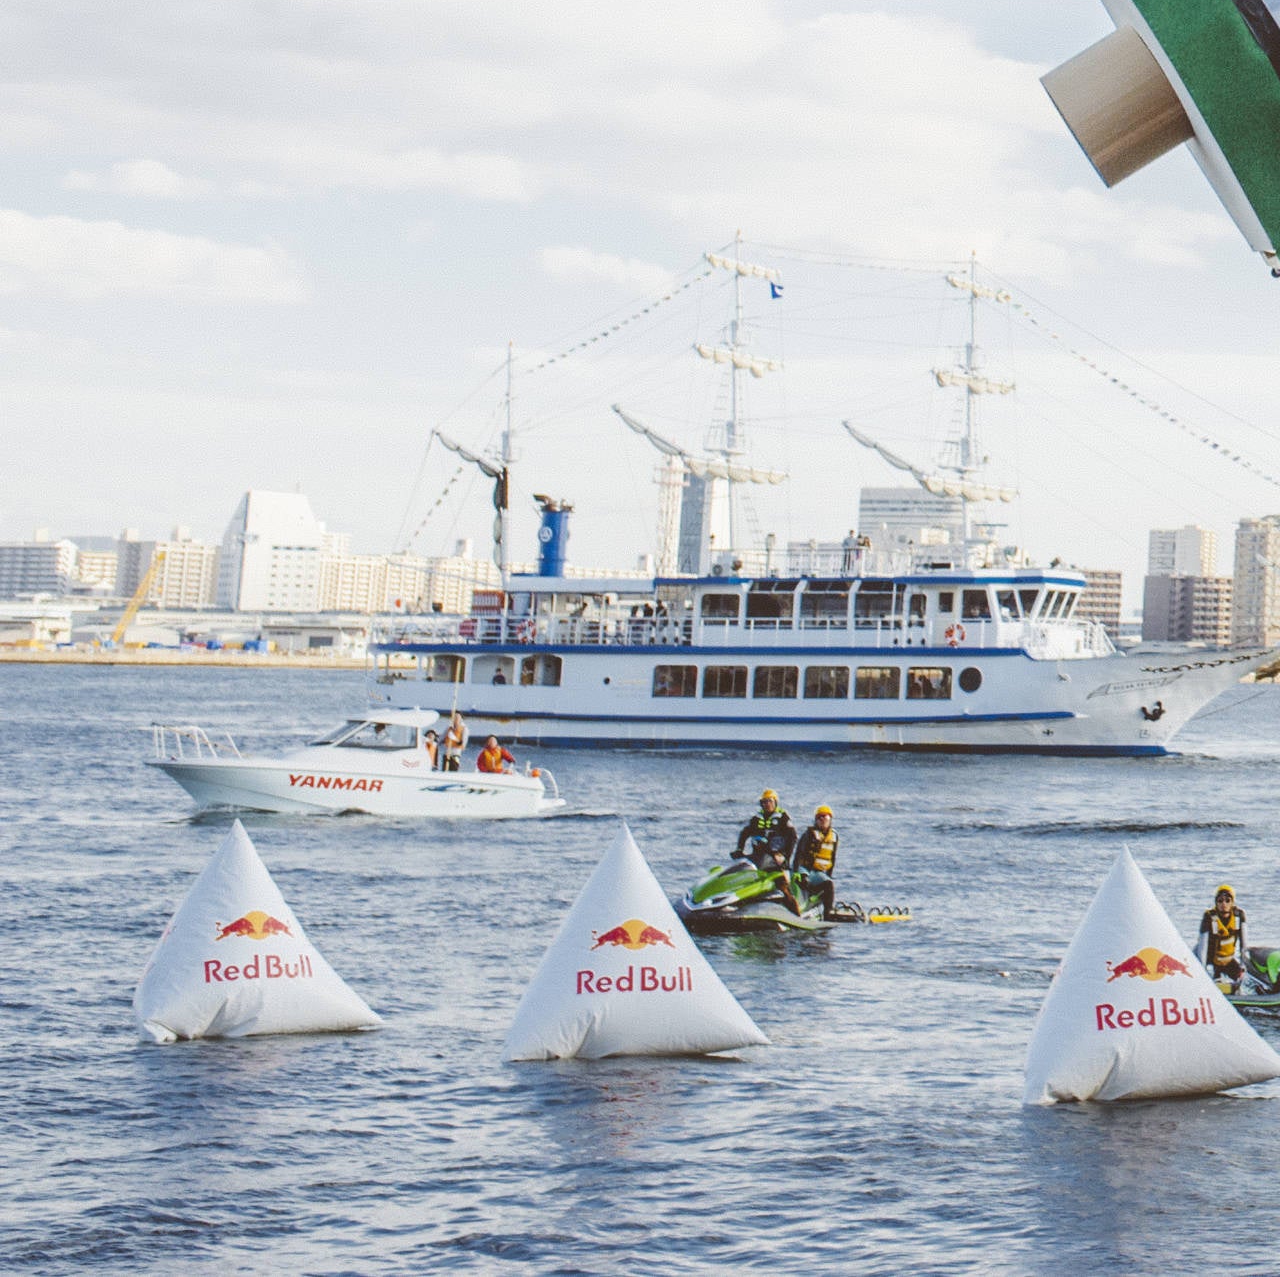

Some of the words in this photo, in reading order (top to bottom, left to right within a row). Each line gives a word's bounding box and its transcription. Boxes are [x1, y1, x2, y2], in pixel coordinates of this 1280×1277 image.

[288, 773, 385, 793] YANMAR
[203, 954, 260, 984] Red
[265, 953, 313, 979] Bull
[576, 965, 634, 995] Red
[640, 965, 693, 992] Bull
[1095, 997, 1156, 1031] Red
[1161, 997, 1216, 1026] Bull
